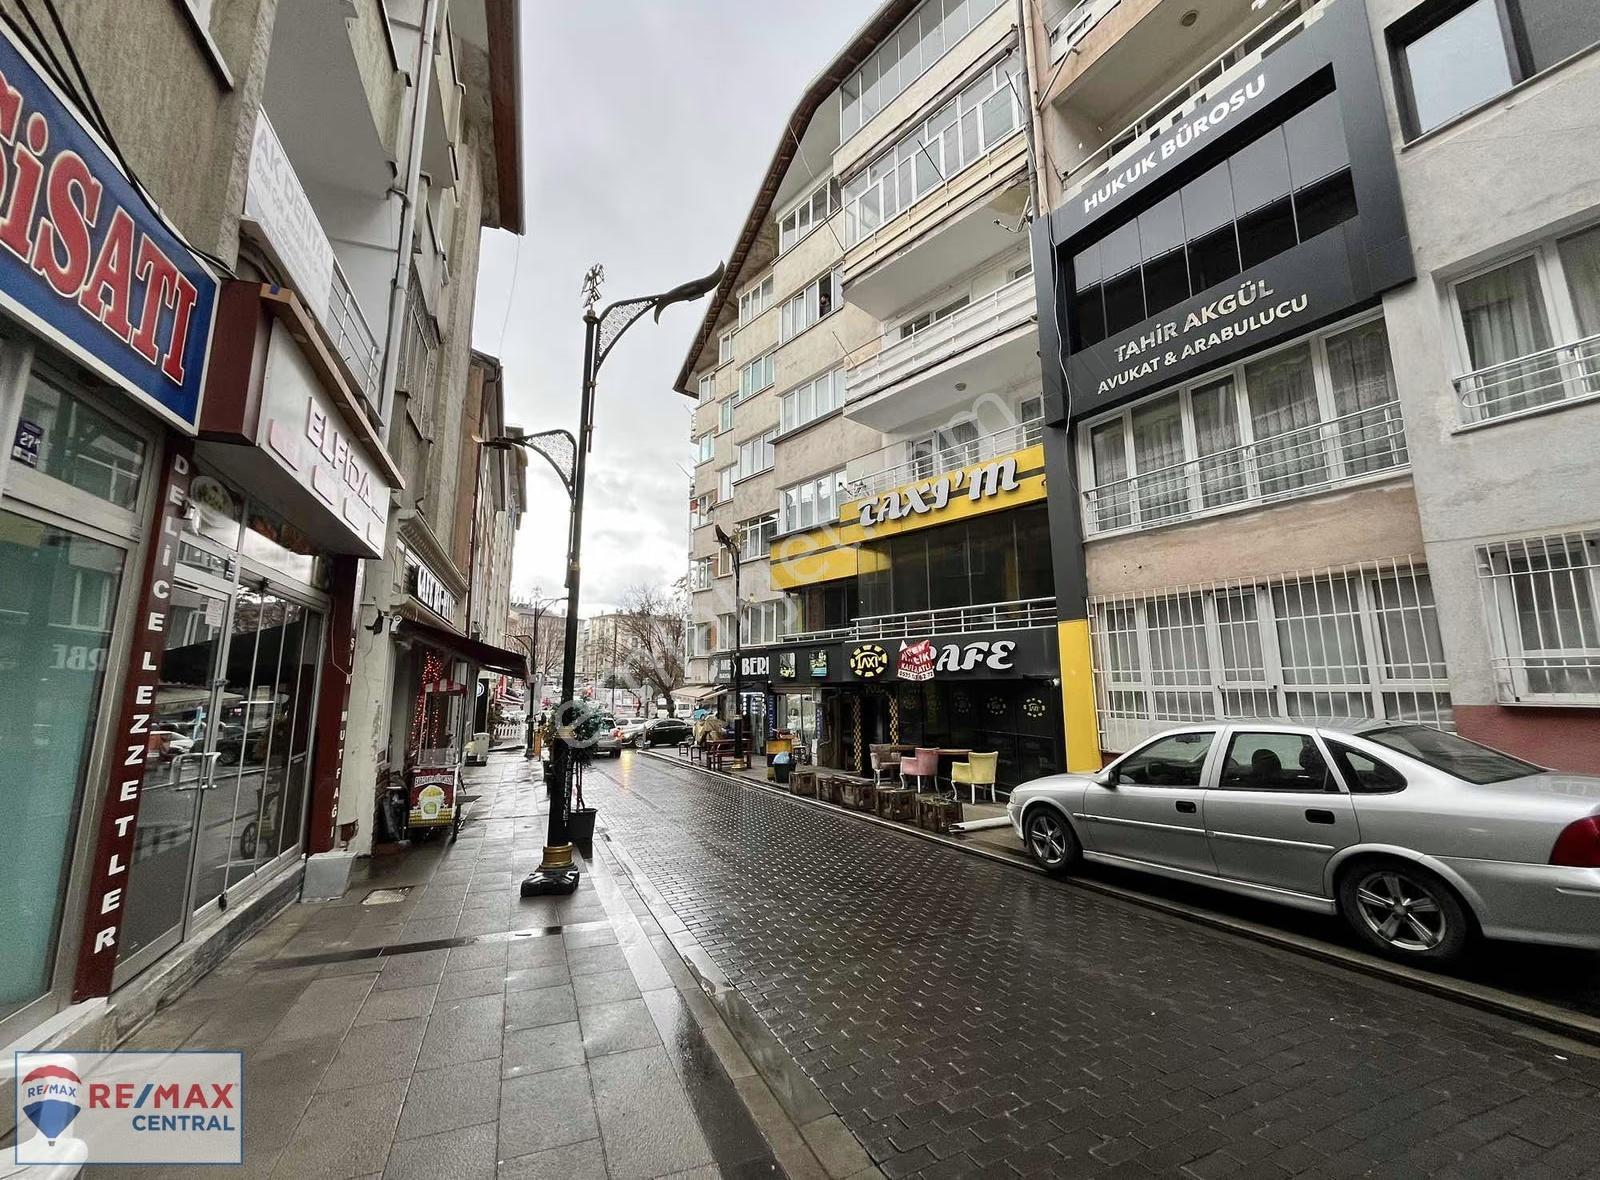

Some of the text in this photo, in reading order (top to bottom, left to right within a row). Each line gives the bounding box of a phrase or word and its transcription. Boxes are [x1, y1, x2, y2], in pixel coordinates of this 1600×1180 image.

[1084, 73, 1267, 214] HUKUK BÜROSU
[1096, 293, 1310, 395] AVUKAT & ARABULUCU
[1112, 278, 1275, 363] TAHİR AKGÜL
